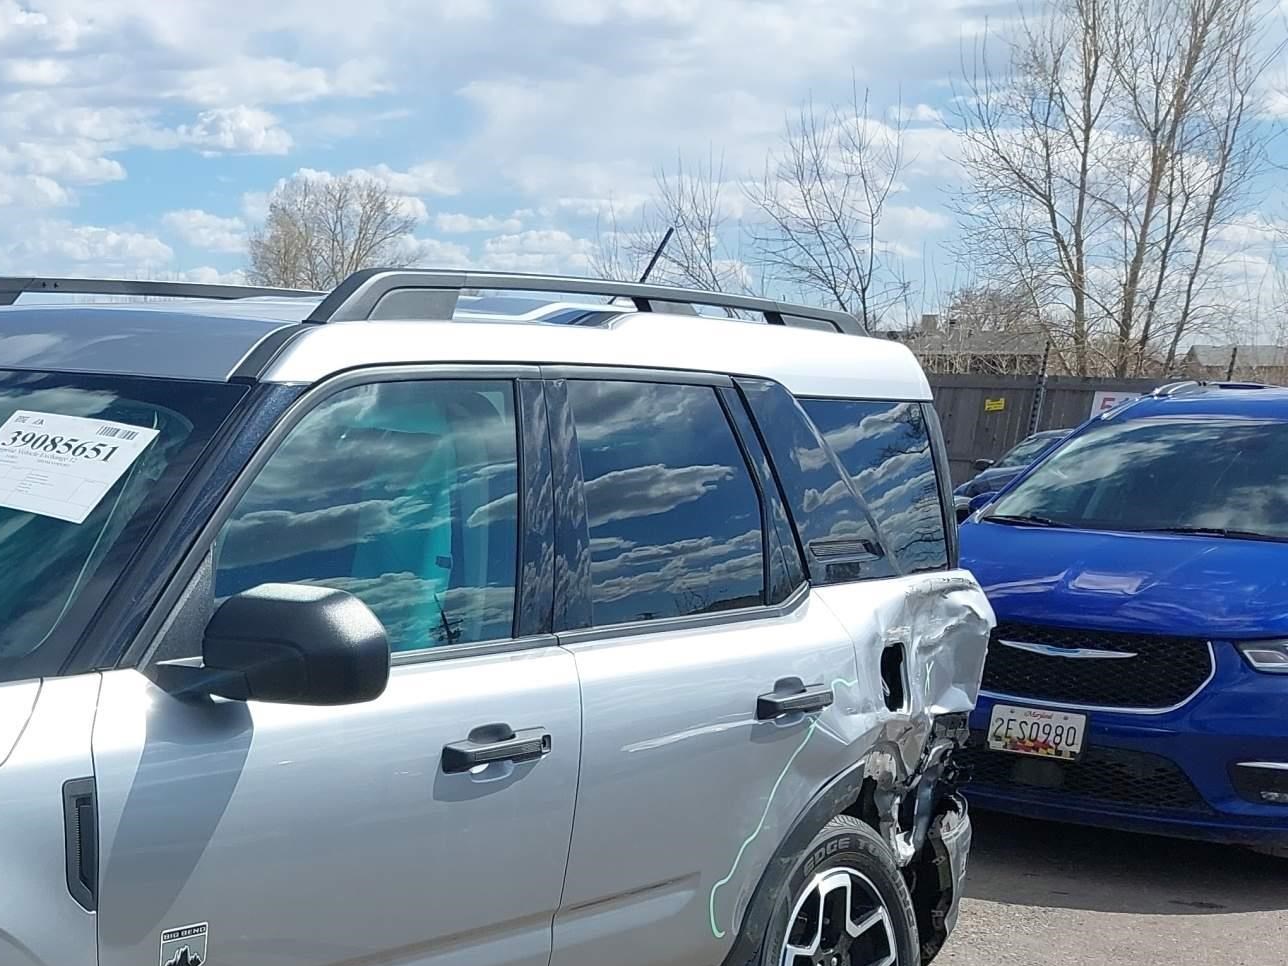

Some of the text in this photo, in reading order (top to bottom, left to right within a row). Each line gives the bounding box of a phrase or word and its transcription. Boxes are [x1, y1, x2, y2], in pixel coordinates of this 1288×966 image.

[1, 430, 120, 462] 39085651
[991, 717, 1077, 747] 2ES0980
[803, 837, 850, 877] EDGE
[163, 926, 206, 940] BIG BEND
